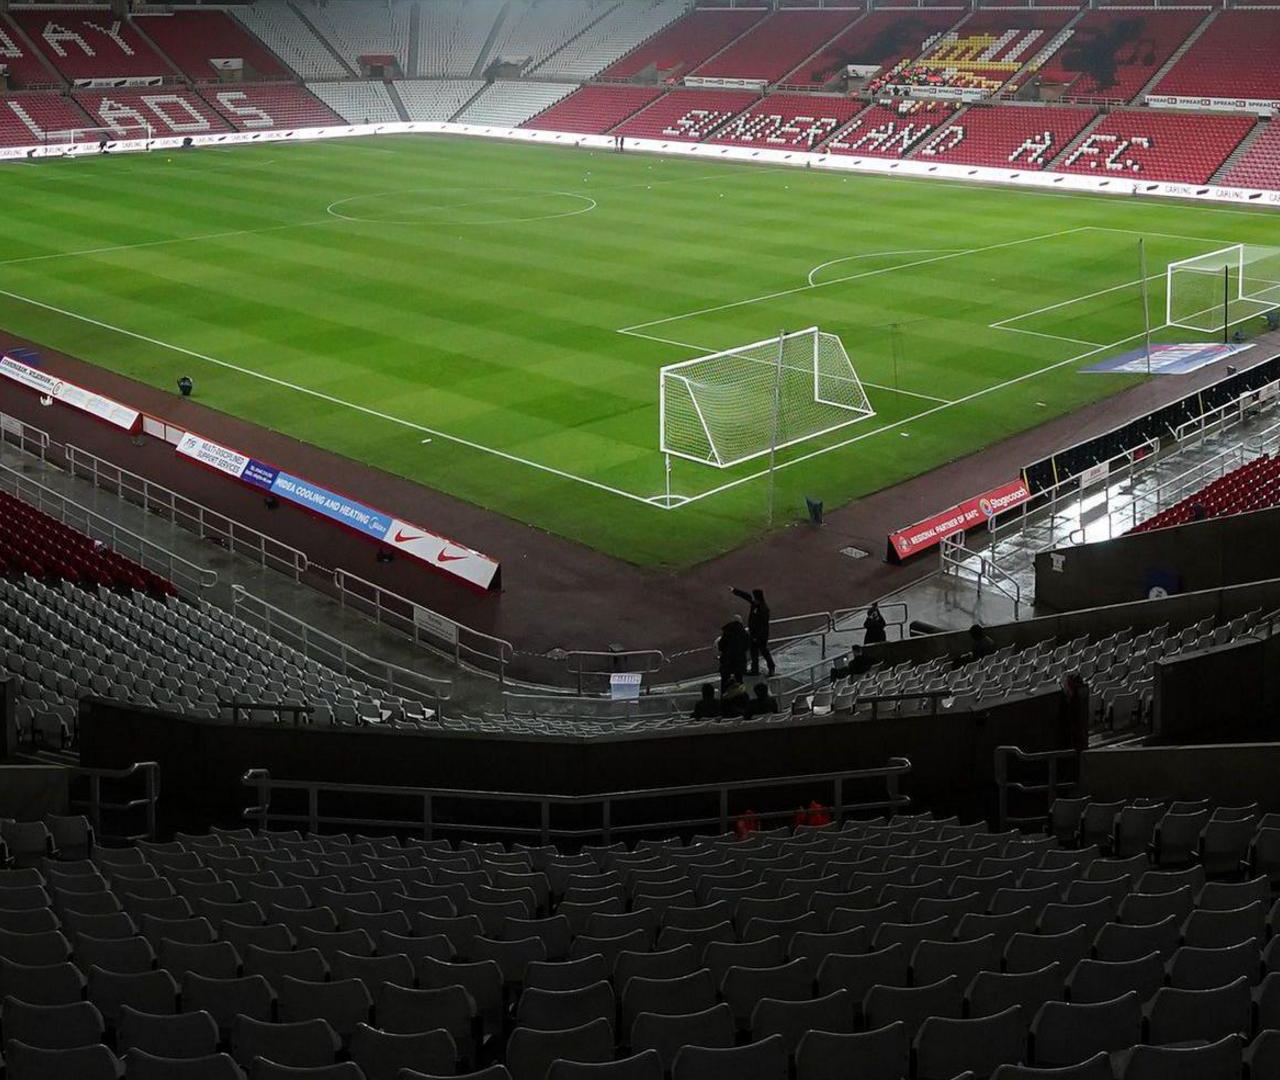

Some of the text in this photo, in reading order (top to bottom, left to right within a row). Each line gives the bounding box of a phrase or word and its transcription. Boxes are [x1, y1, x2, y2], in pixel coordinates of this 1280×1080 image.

[7, 91, 274, 141] LADS
[662, 109, 964, 155] SUNDERLAND
[1165, 185, 1192, 195] CARLING
[1215, 189, 1244, 199] CARLING
[295, 485, 326, 505] COOLING
[324, 499, 341, 512] AND
[339, 504, 370, 525] HEATING
[990, 486, 1028, 509] Stagecoach
[957, 516, 965, 525] OF
